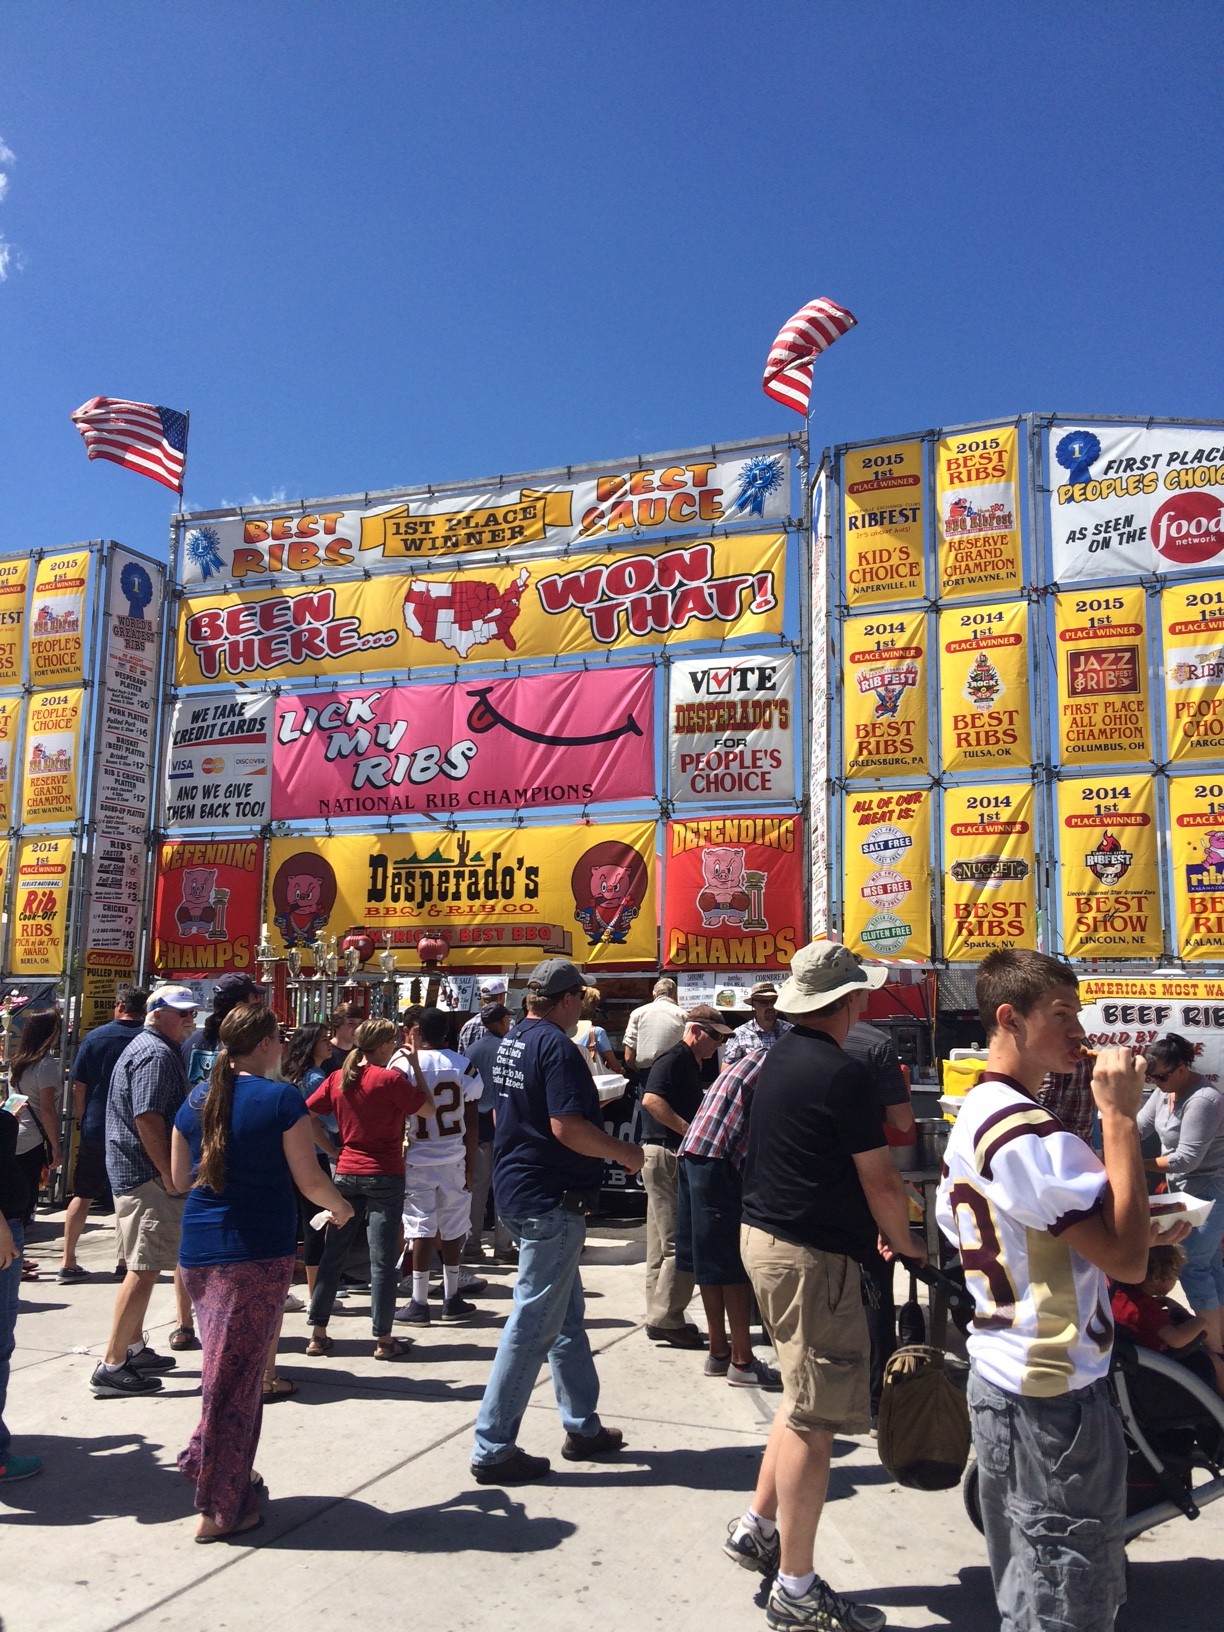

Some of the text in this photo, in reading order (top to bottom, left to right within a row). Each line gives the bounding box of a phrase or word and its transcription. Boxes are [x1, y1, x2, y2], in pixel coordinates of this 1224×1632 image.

[956, 438, 1000, 454] 2015
[862, 453, 904, 469] 2015
[946, 450, 1008, 472] BEST
[596, 462, 717, 502] BEST
[949, 464, 1006, 485] RIBS
[854, 477, 914, 492] PLACE WINNER
[1057, 464, 1224, 505] PEOPLE'S CHOIC
[392, 504, 537, 536] 1ST PLACE
[578, 488, 725, 537] SAUCE
[849, 508, 920, 531] RIBFEST
[243, 512, 345, 544] BEST
[1065, 514, 1135, 544] AS SEEN
[1156, 507, 1224, 551] food
[400, 524, 527, 551] WINNER
[949, 534, 1009, 552] RESERVE
[1088, 526, 1147, 553] ON THE
[1175, 535, 1217, 546] network
[231, 538, 355, 578] RIBS
[858, 546, 910, 567] KID'S
[955, 547, 1003, 563] GRAND
[849, 562, 920, 585] CHOICE
[944, 558, 1015, 577] CHAMPION
[537, 543, 714, 613] WON
[583, 572, 778, 643] THAT!
[1076, 598, 1124, 613] 2015
[187, 590, 335, 643] BEEN
[960, 611, 1004, 627] 2014
[1088, 614, 1113, 629] 1st
[864, 622, 906, 636] 2014
[972, 626, 994, 640] 1st
[1065, 627, 1136, 639] PLACE WINNER
[1175, 622, 1206, 633] PLACE
[31, 637, 81, 654] PEOPLE'S
[124, 638, 146, 652] RIBS
[874, 637, 896, 652] 1st
[950, 636, 1016, 651] PLACE WINNER
[36, 652, 77, 669] CHOICE
[854, 649, 917, 662] PLACE WINNER
[1073, 652, 1133, 673] JAZZ
[115, 670, 148, 687] DESPERADO
[120, 681, 142, 693] PLATTER
[970, 679, 997, 688] ROCK
[32, 706, 78, 720] PEOPLE'S
[109, 706, 149, 724] PORK PLATTER
[190, 702, 248, 725] WE TAKE
[674, 698, 790, 734] DESPERADO'S
[1063, 700, 1144, 716] FIRST PLACE
[33, 719, 72, 732] CHOICE
[278, 691, 382, 745] LICK
[953, 710, 1019, 731] BEST
[1069, 713, 1139, 729] ALL OHIO
[172, 716, 267, 746] CREDIT CARDS
[855, 720, 916, 740] BEST
[955, 728, 1018, 748] RIBS
[1066, 726, 1144, 742] CHAMPION
[116, 736, 139, 748] BRISKET
[324, 720, 409, 762] MY
[714, 738, 747, 748] FOR
[857, 738, 915, 757] RIBS
[125, 746, 145, 758] PLATTER
[680, 748, 782, 773] PEOPLE'S
[172, 759, 193, 771] VISA
[351, 739, 479, 790] RIBS
[30, 775, 68, 787] RESERVE
[690, 771, 772, 793] CHOICE
[33, 785, 64, 796] GRAND
[176, 782, 253, 802] AND WE GIVE
[319, 783, 594, 814] NATIONAL RIB CHAMPIONS
[1082, 786, 1131, 801] 2014
[27, 795, 71, 807] CHAMPION
[853, 791, 923, 813] ALL OF OUR
[966, 796, 1012, 809] 2014
[1094, 802, 1119, 817] 1st
[167, 801, 266, 821] THEM BACK TOO!
[978, 810, 1001, 825] 1st
[956, 824, 1022, 834] PLACE WINNER
[1071, 816, 1144, 826] PLACE WINNER
[1183, 816, 1215, 825] PLACE
[110, 840, 132, 851] RIBS
[672, 818, 795, 858] DEFENDING
[862, 836, 912, 854] SALT FREE
[161, 842, 258, 874] DEFENDING
[1085, 854, 1132, 866] RIBFEST
[962, 862, 1017, 878] NUGGET
[366, 851, 540, 909] Desperado's
[863, 881, 910, 897] MSG FREE
[23, 889, 57, 914] Rib
[364, 903, 538, 917] BBQ & RIB CO.
[1075, 896, 1149, 914] BEST
[954, 902, 1027, 919] BEST
[1103, 907, 1120, 923] of
[21, 924, 53, 937] RIBS
[956, 920, 1025, 937] RIBS
[1076, 915, 1149, 932] SHOW
[862, 926, 911, 941] GLUTEN FREE
[154, 935, 251, 969] CHAMPS
[669, 926, 797, 965] CHAMPS
[86, 968, 132, 979] PULLED PORK
[755, 973, 789, 982] CORNBREAD
[1085, 982, 1224, 996] AMERICA'S MOST WA
[1102, 1004, 1224, 1027] BEEF RIB
[1087, 1030, 1159, 1047] SOLD BY
